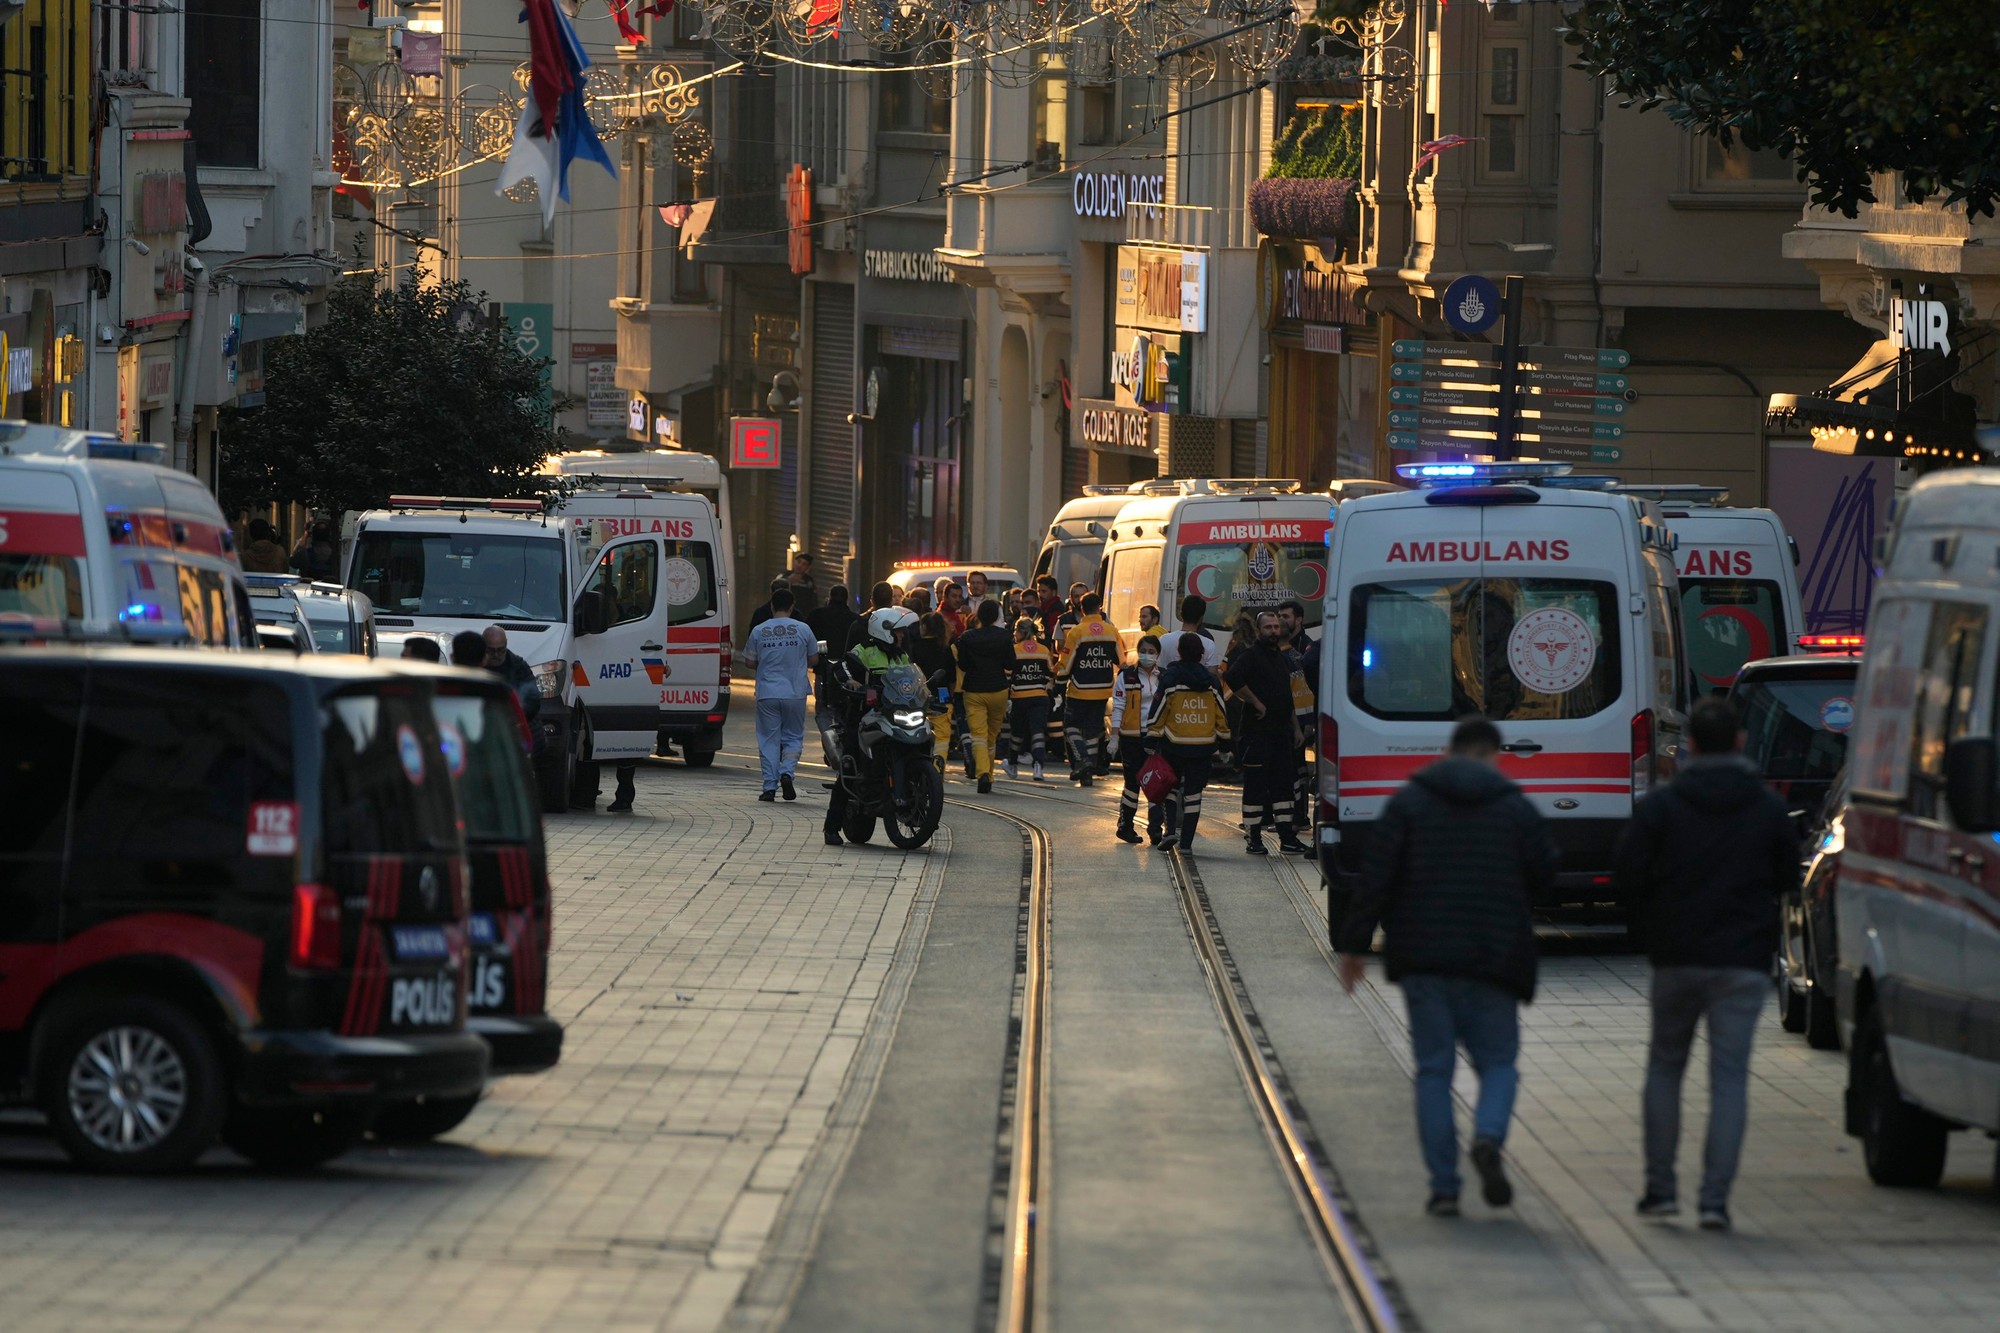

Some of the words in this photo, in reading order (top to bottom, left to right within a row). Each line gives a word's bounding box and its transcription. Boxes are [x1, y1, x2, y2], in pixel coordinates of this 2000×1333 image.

[1074, 172, 1126, 217] GOLDEN
[1131, 174, 1164, 219] ROSE
[864, 249, 918, 280] STARBUCKS
[601, 364, 611, 373] 50
[1083, 409, 1120, 446] GOLDEN
[1123, 414, 1147, 448] ROSE
[744, 429, 769, 458] E
[1209, 524, 1302, 540] AMBULANS
[1386, 540, 1569, 562] AMBULANS
[1086, 646, 1106, 657] ACİL
[600, 663, 632, 679] AFAD
[1022, 662, 1042, 673] ACİL
[1080, 658, 1112, 669] SAĞLIK
[1182, 696, 1207, 709] ACİL
[255, 805, 292, 833] 112
[392, 971, 454, 1025] POLİS
